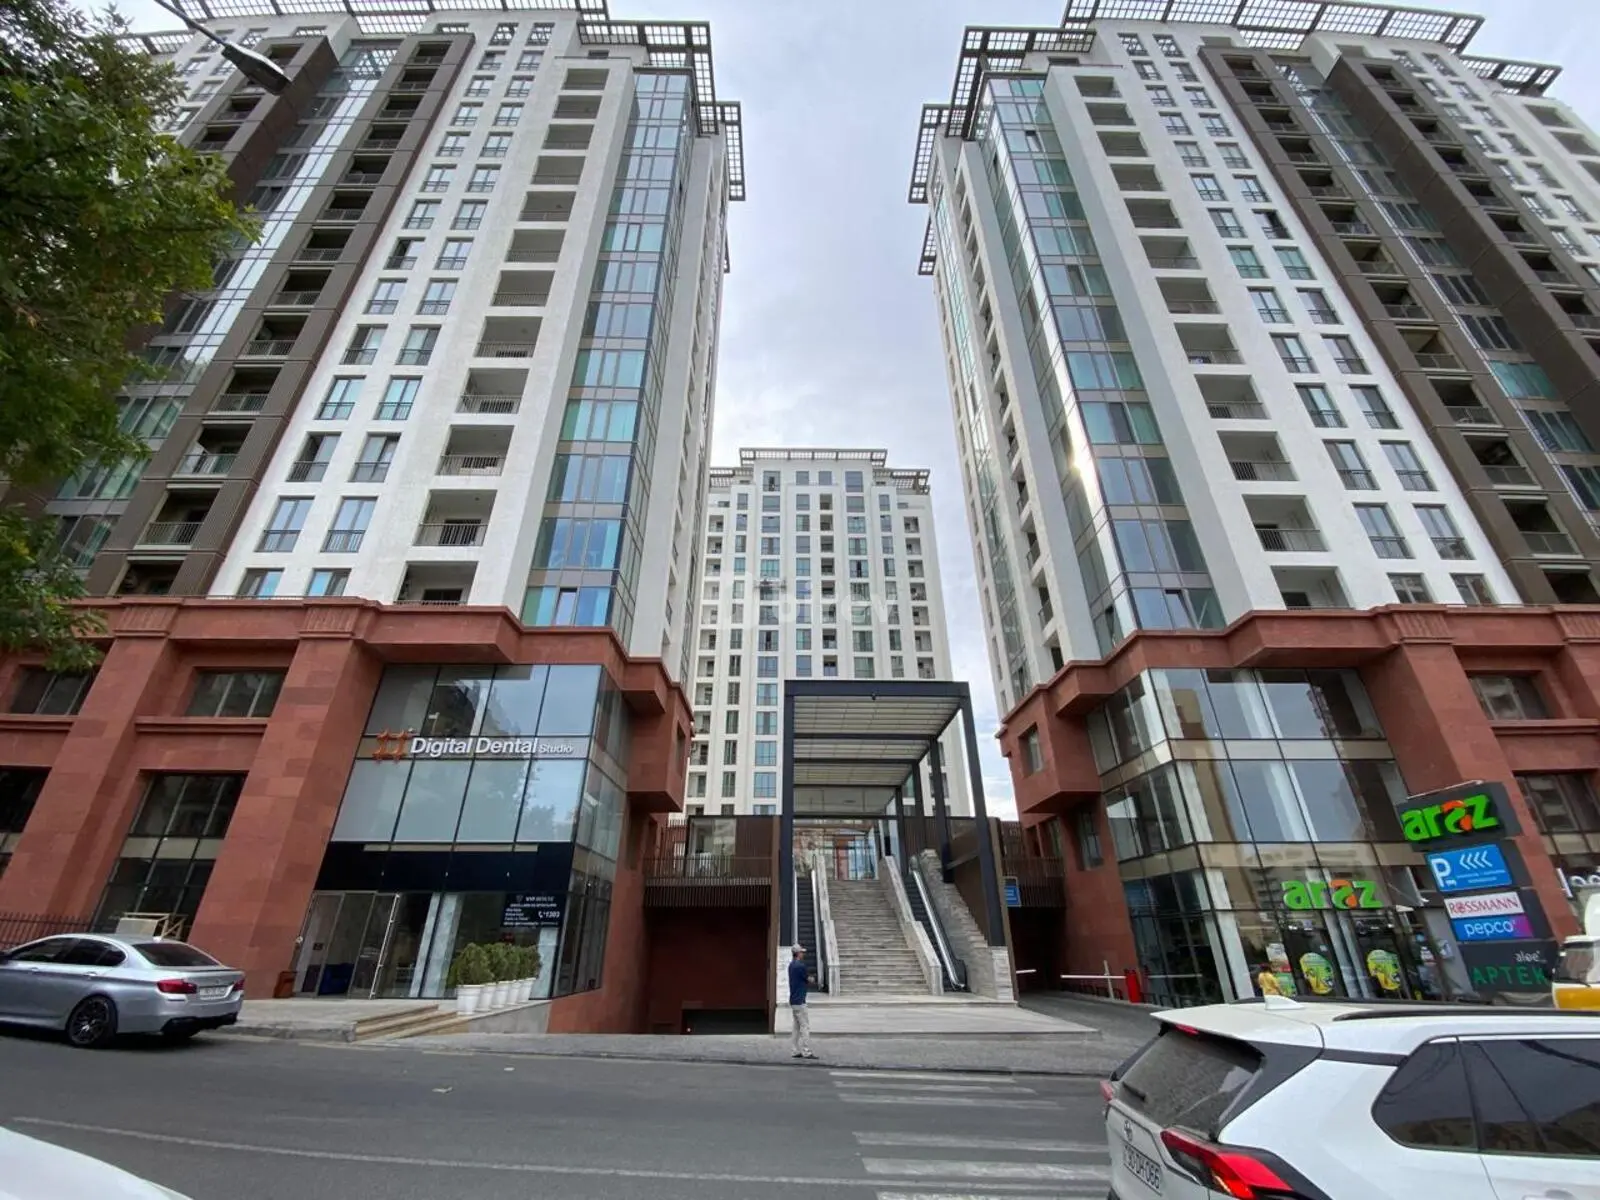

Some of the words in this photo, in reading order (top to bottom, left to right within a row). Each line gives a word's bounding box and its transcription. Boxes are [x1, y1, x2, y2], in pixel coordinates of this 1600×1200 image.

[411, 737, 471, 757] Digital
[475, 737, 538, 754] Dental
[539, 743, 573, 754] Studio
[1401, 794, 1498, 842] araz
[1281, 879, 1383, 910] araz
[1449, 897, 1520, 914] ROSSMANN
[1464, 920, 1514, 938] pepco
